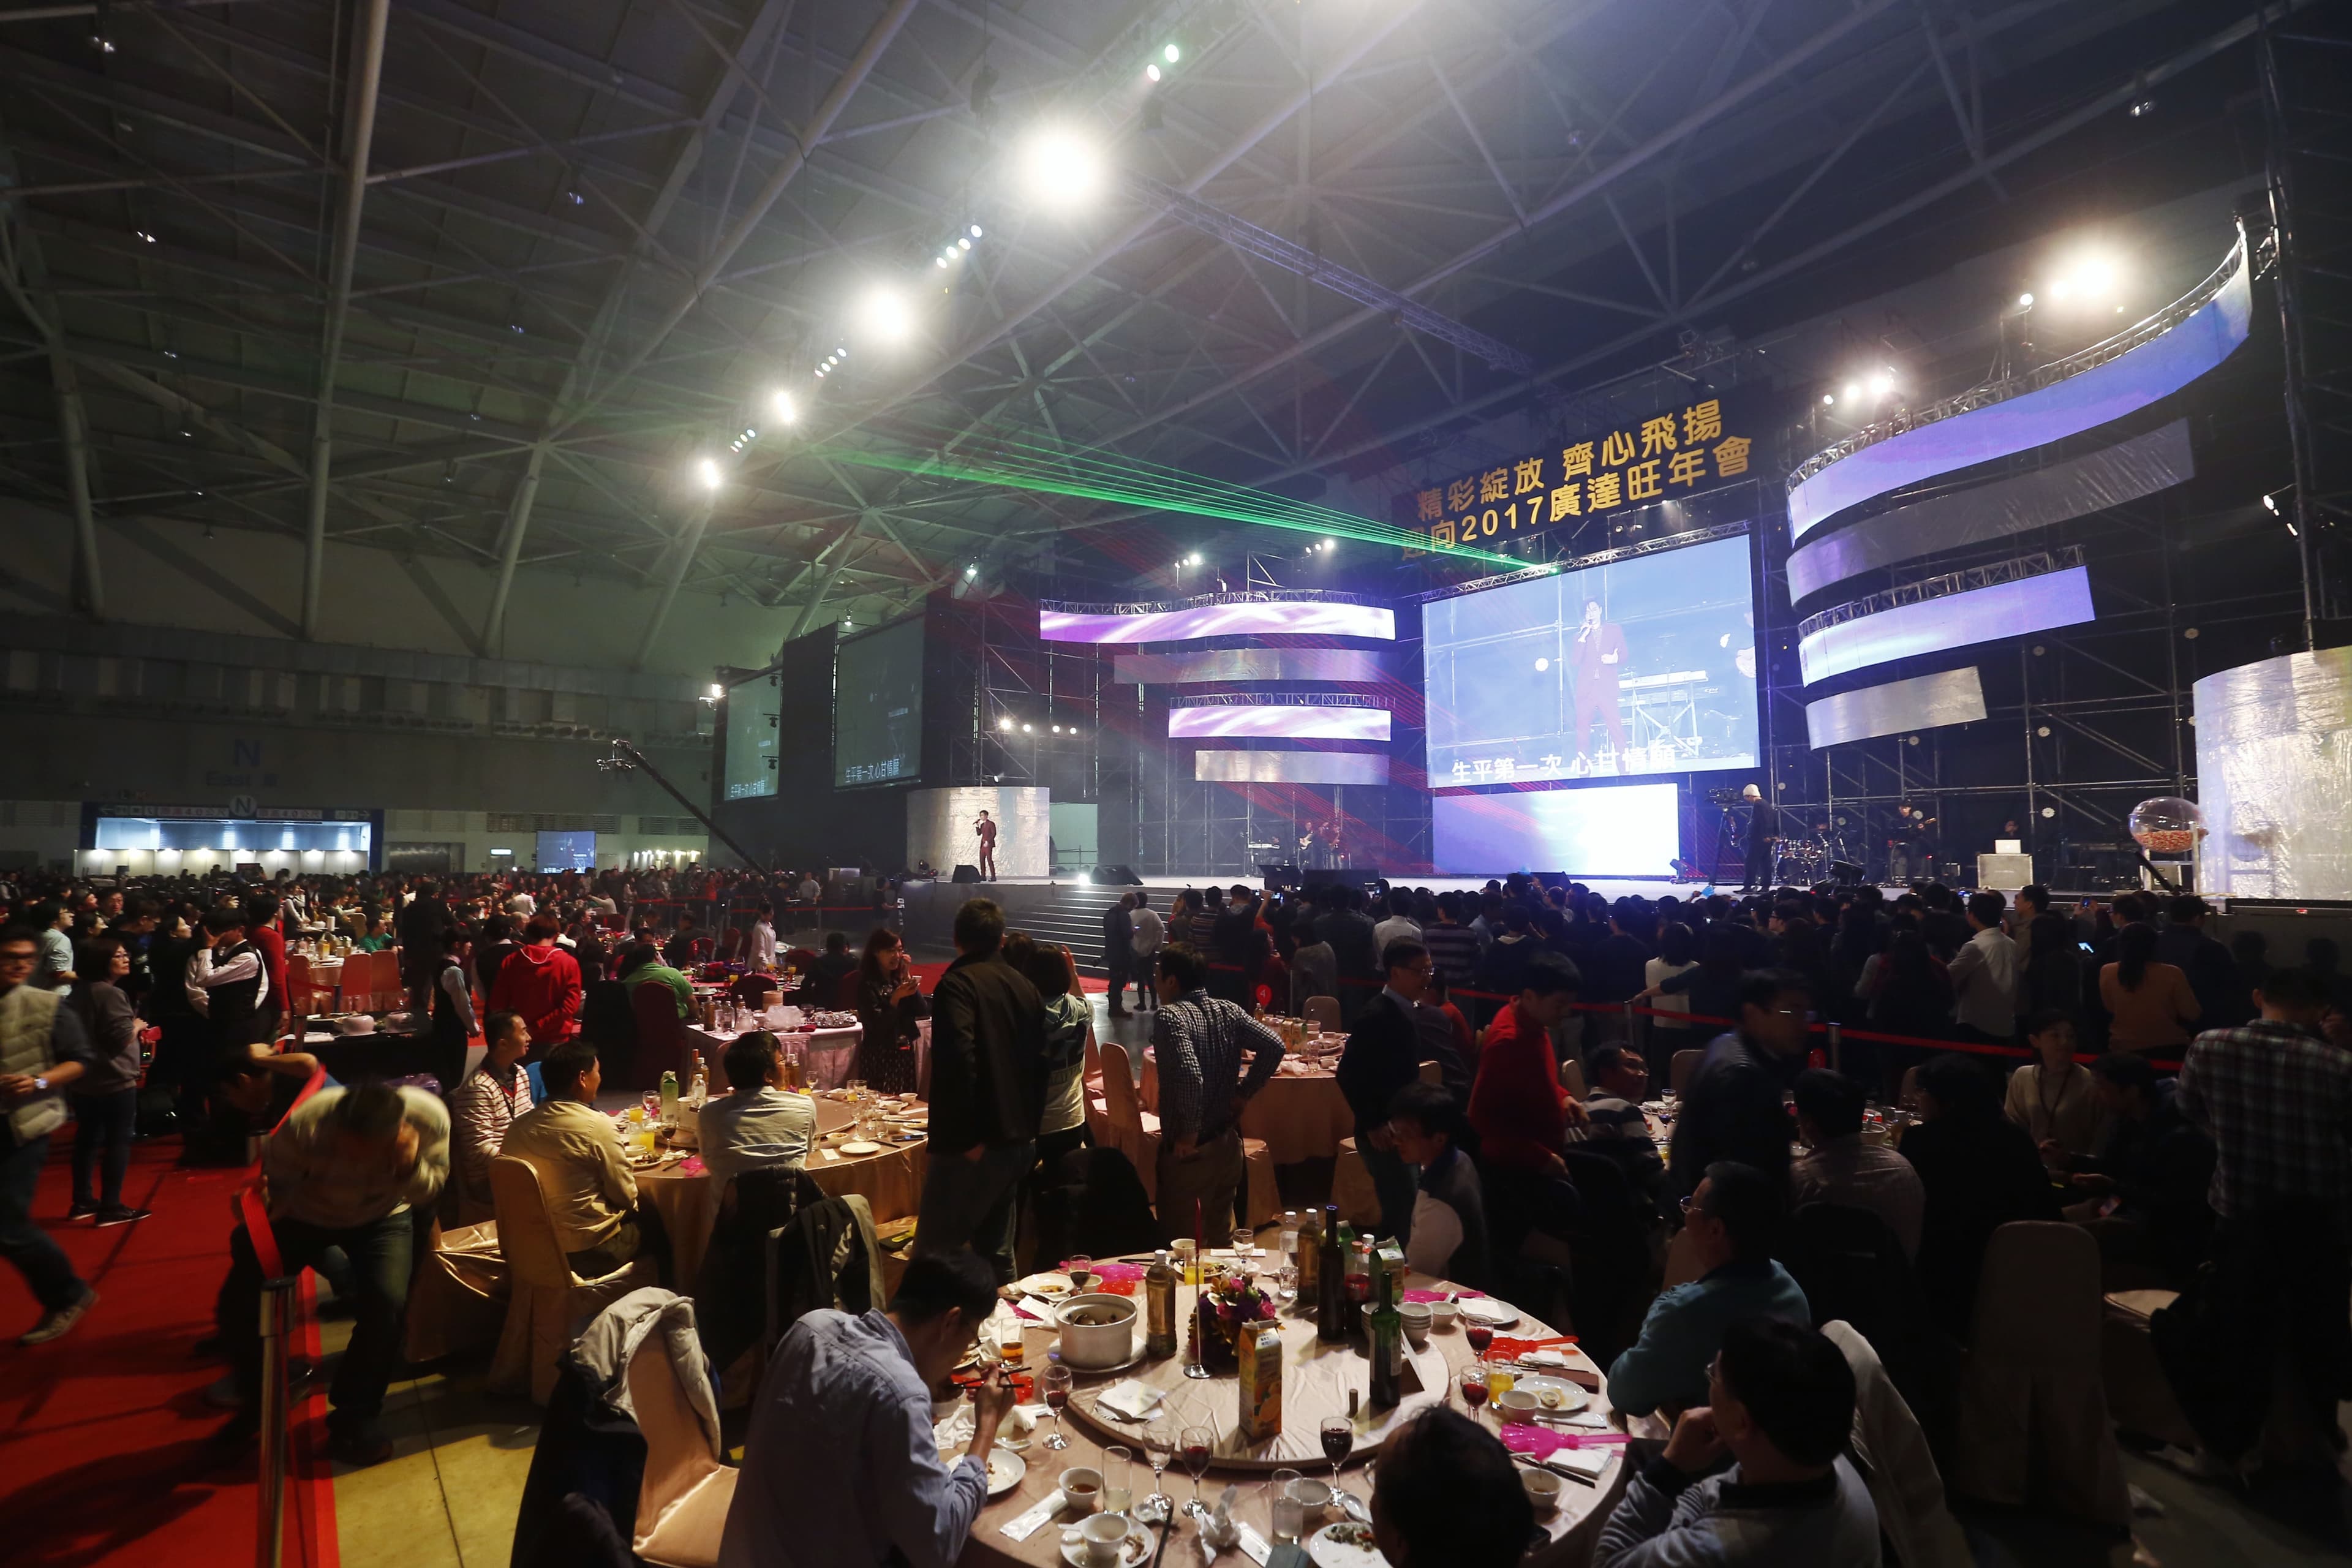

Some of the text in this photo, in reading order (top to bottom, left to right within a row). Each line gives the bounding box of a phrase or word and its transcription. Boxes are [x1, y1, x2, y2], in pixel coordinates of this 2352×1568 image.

[1416, 399, 1722, 521] 精彩綻放 齊心飛揚
[235, 739, 260, 767] N
[1451, 740, 1676, 783] 生平第一次 心甘情願
[235, 797, 252, 815] N
[1259, 989, 1267, 998] 4
